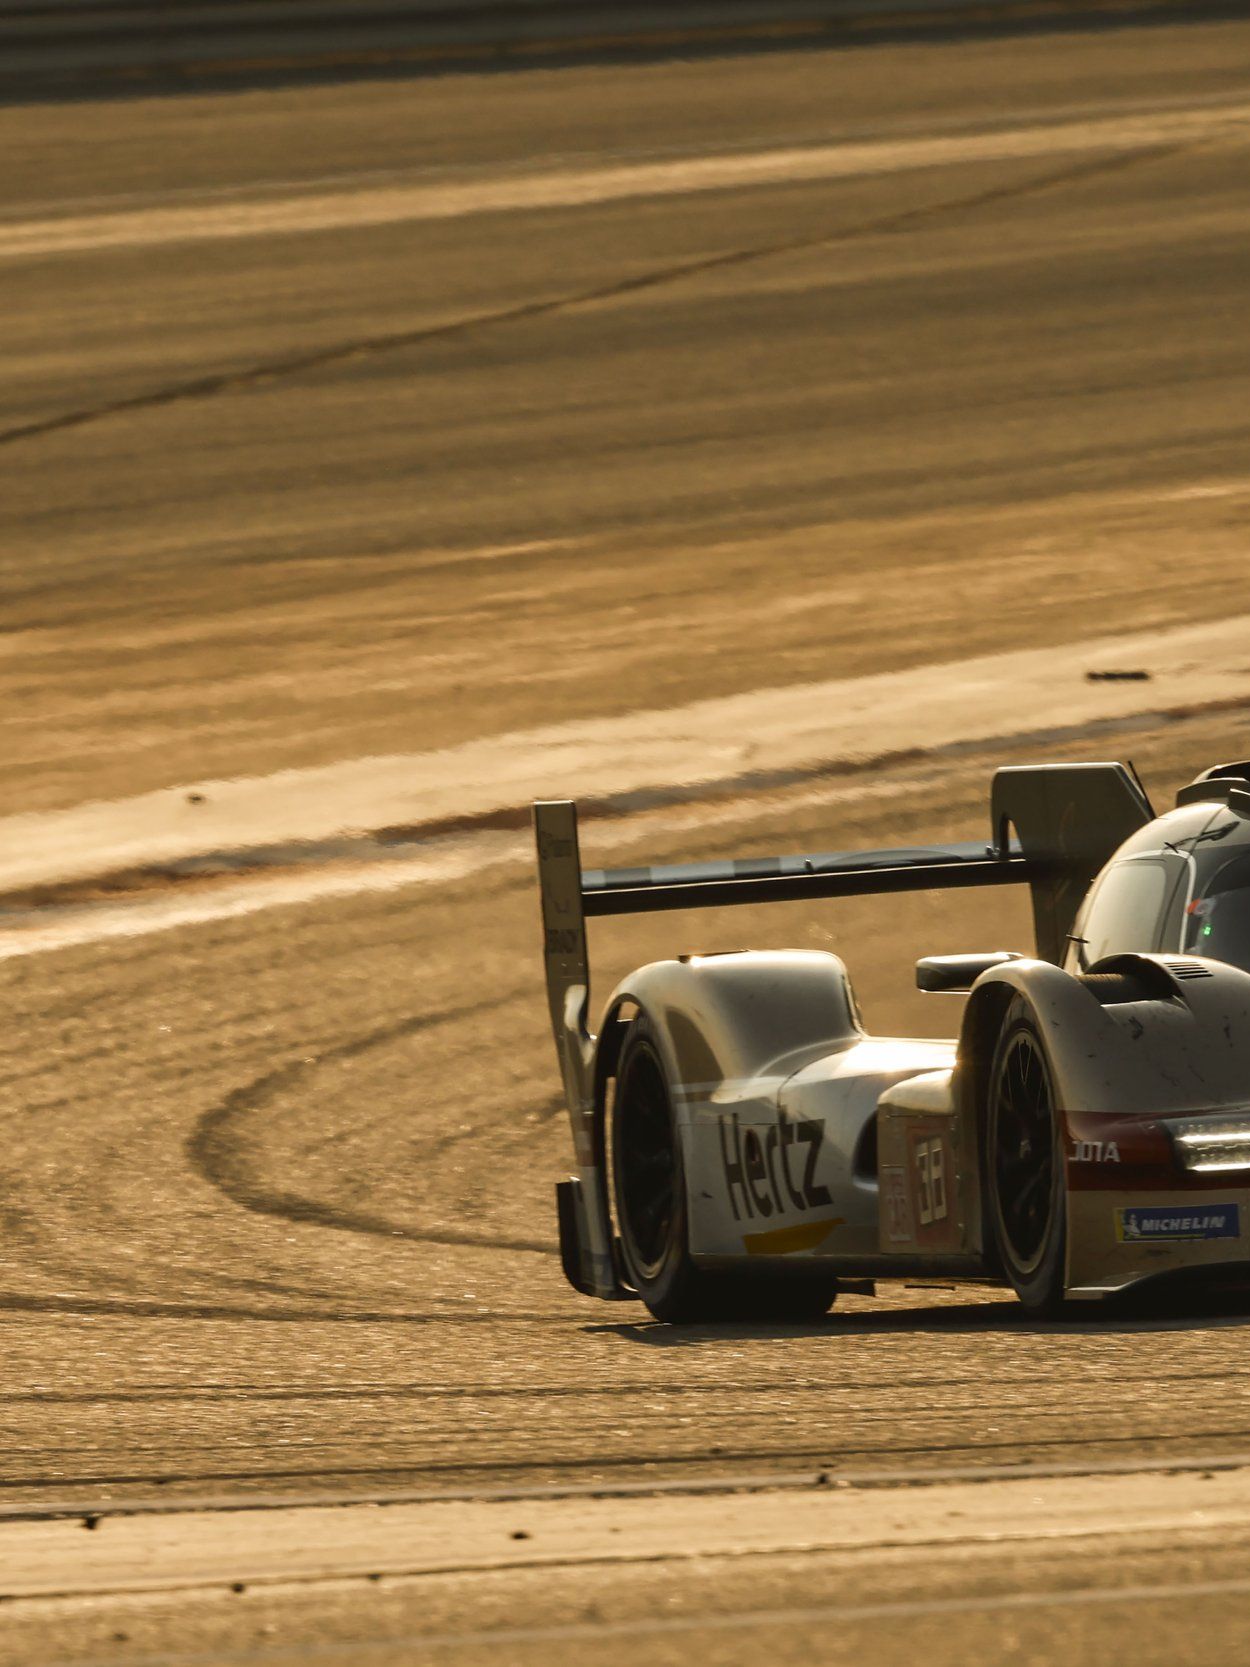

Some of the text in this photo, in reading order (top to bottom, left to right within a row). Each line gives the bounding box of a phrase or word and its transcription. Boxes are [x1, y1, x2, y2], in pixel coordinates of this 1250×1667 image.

[718, 1104, 835, 1221] Hertz
[1068, 1140, 1121, 1163] JOTA
[1141, 1215, 1227, 1232] MICHELIN
